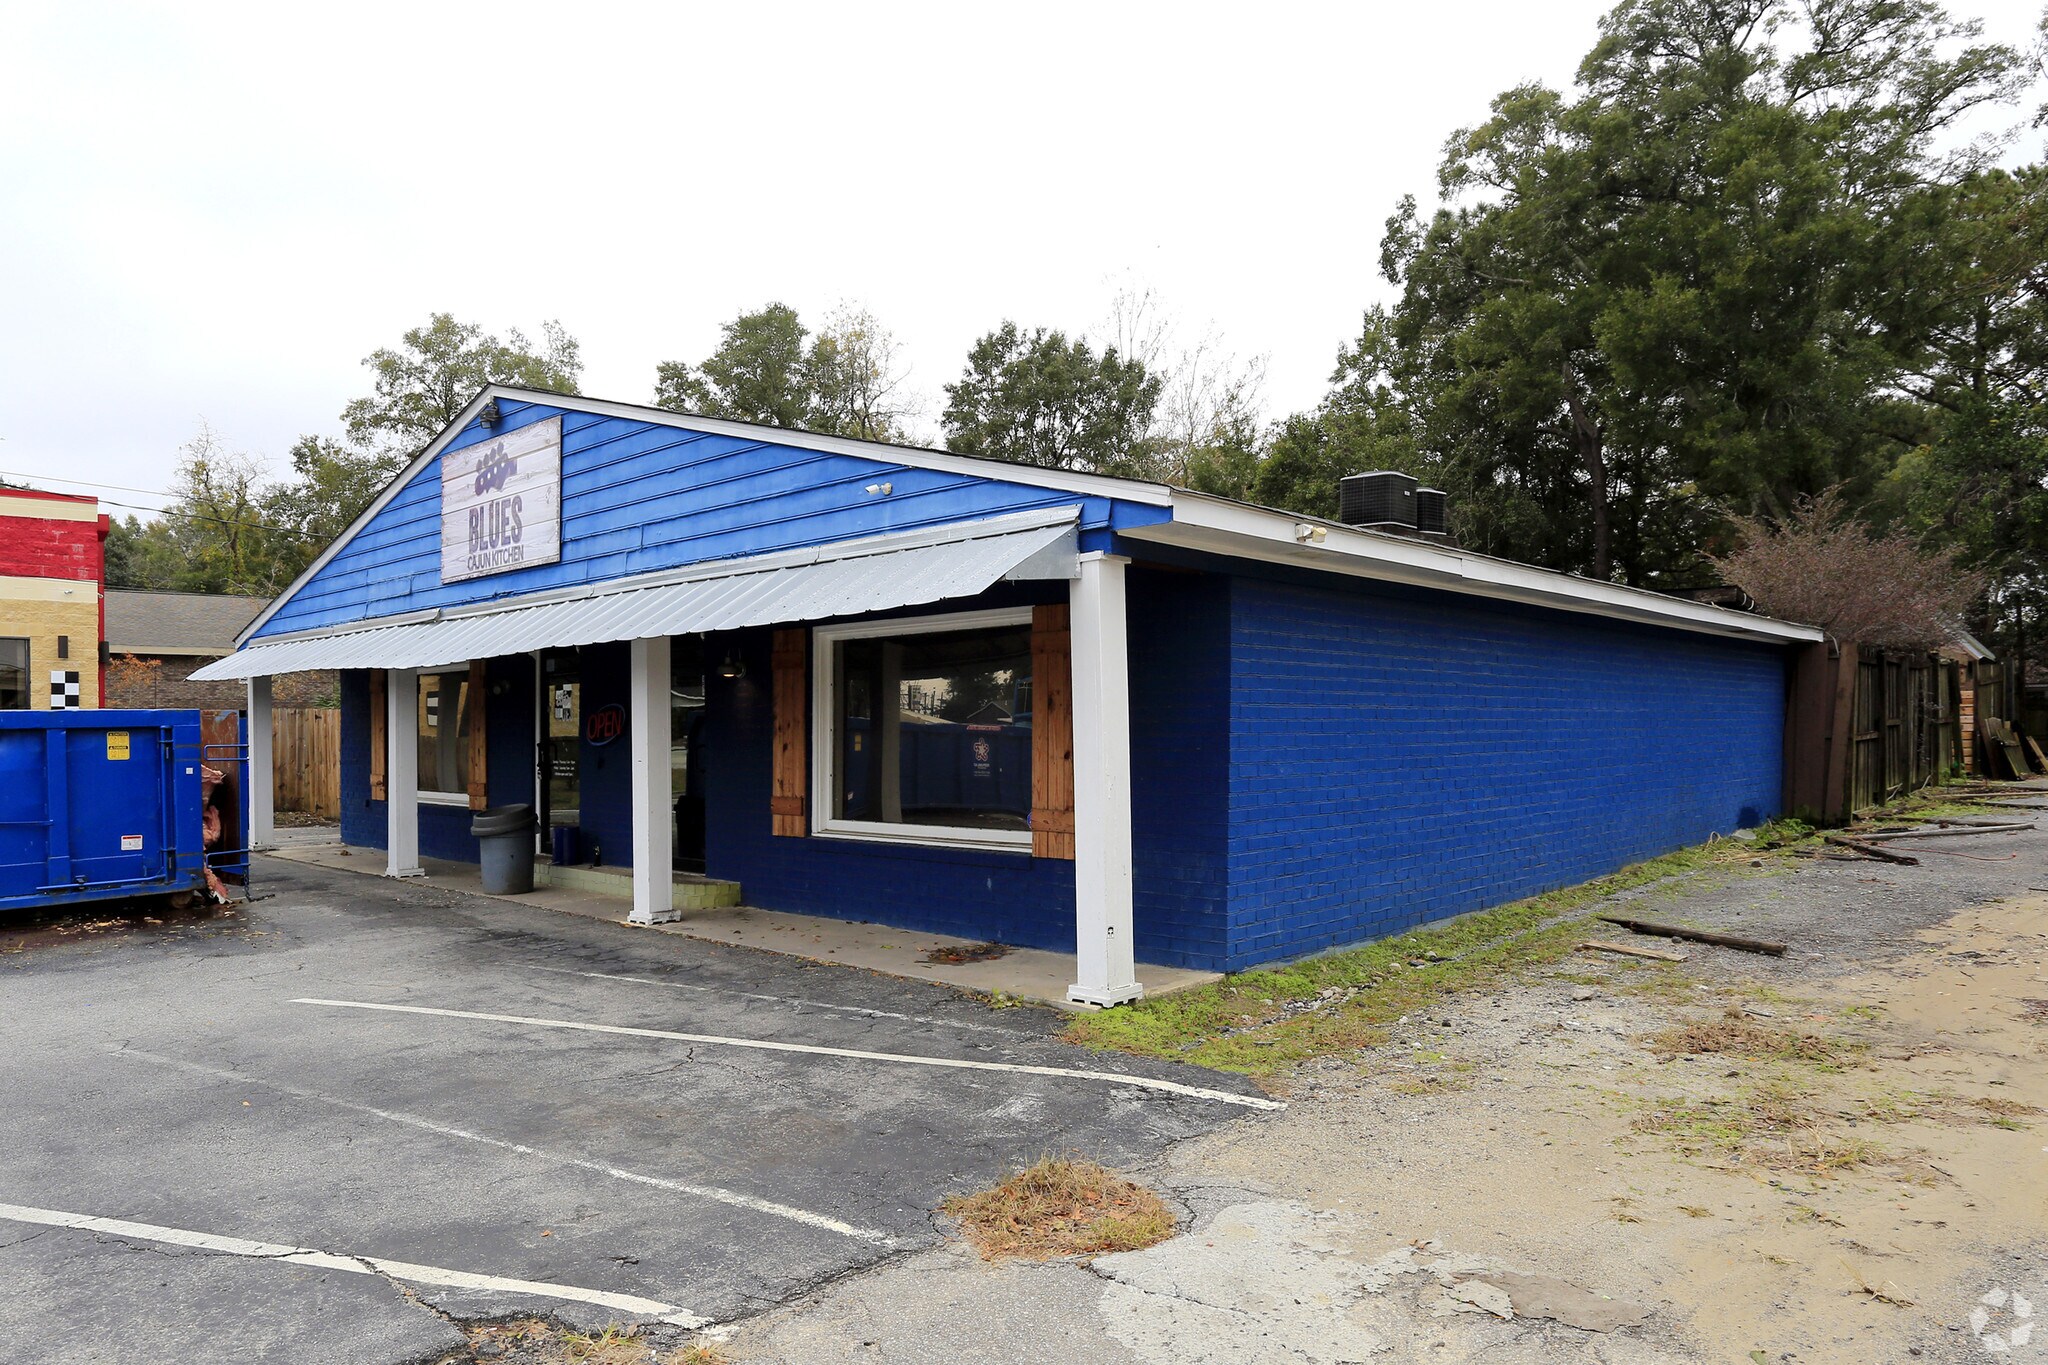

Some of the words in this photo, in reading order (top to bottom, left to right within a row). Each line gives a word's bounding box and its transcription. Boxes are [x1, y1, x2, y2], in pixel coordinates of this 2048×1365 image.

[469, 495, 523, 554] BLUES
[467, 552, 491, 571] CAJUN
[491, 546, 524, 564] KITCHEN
[587, 710, 622, 740] OPEN
